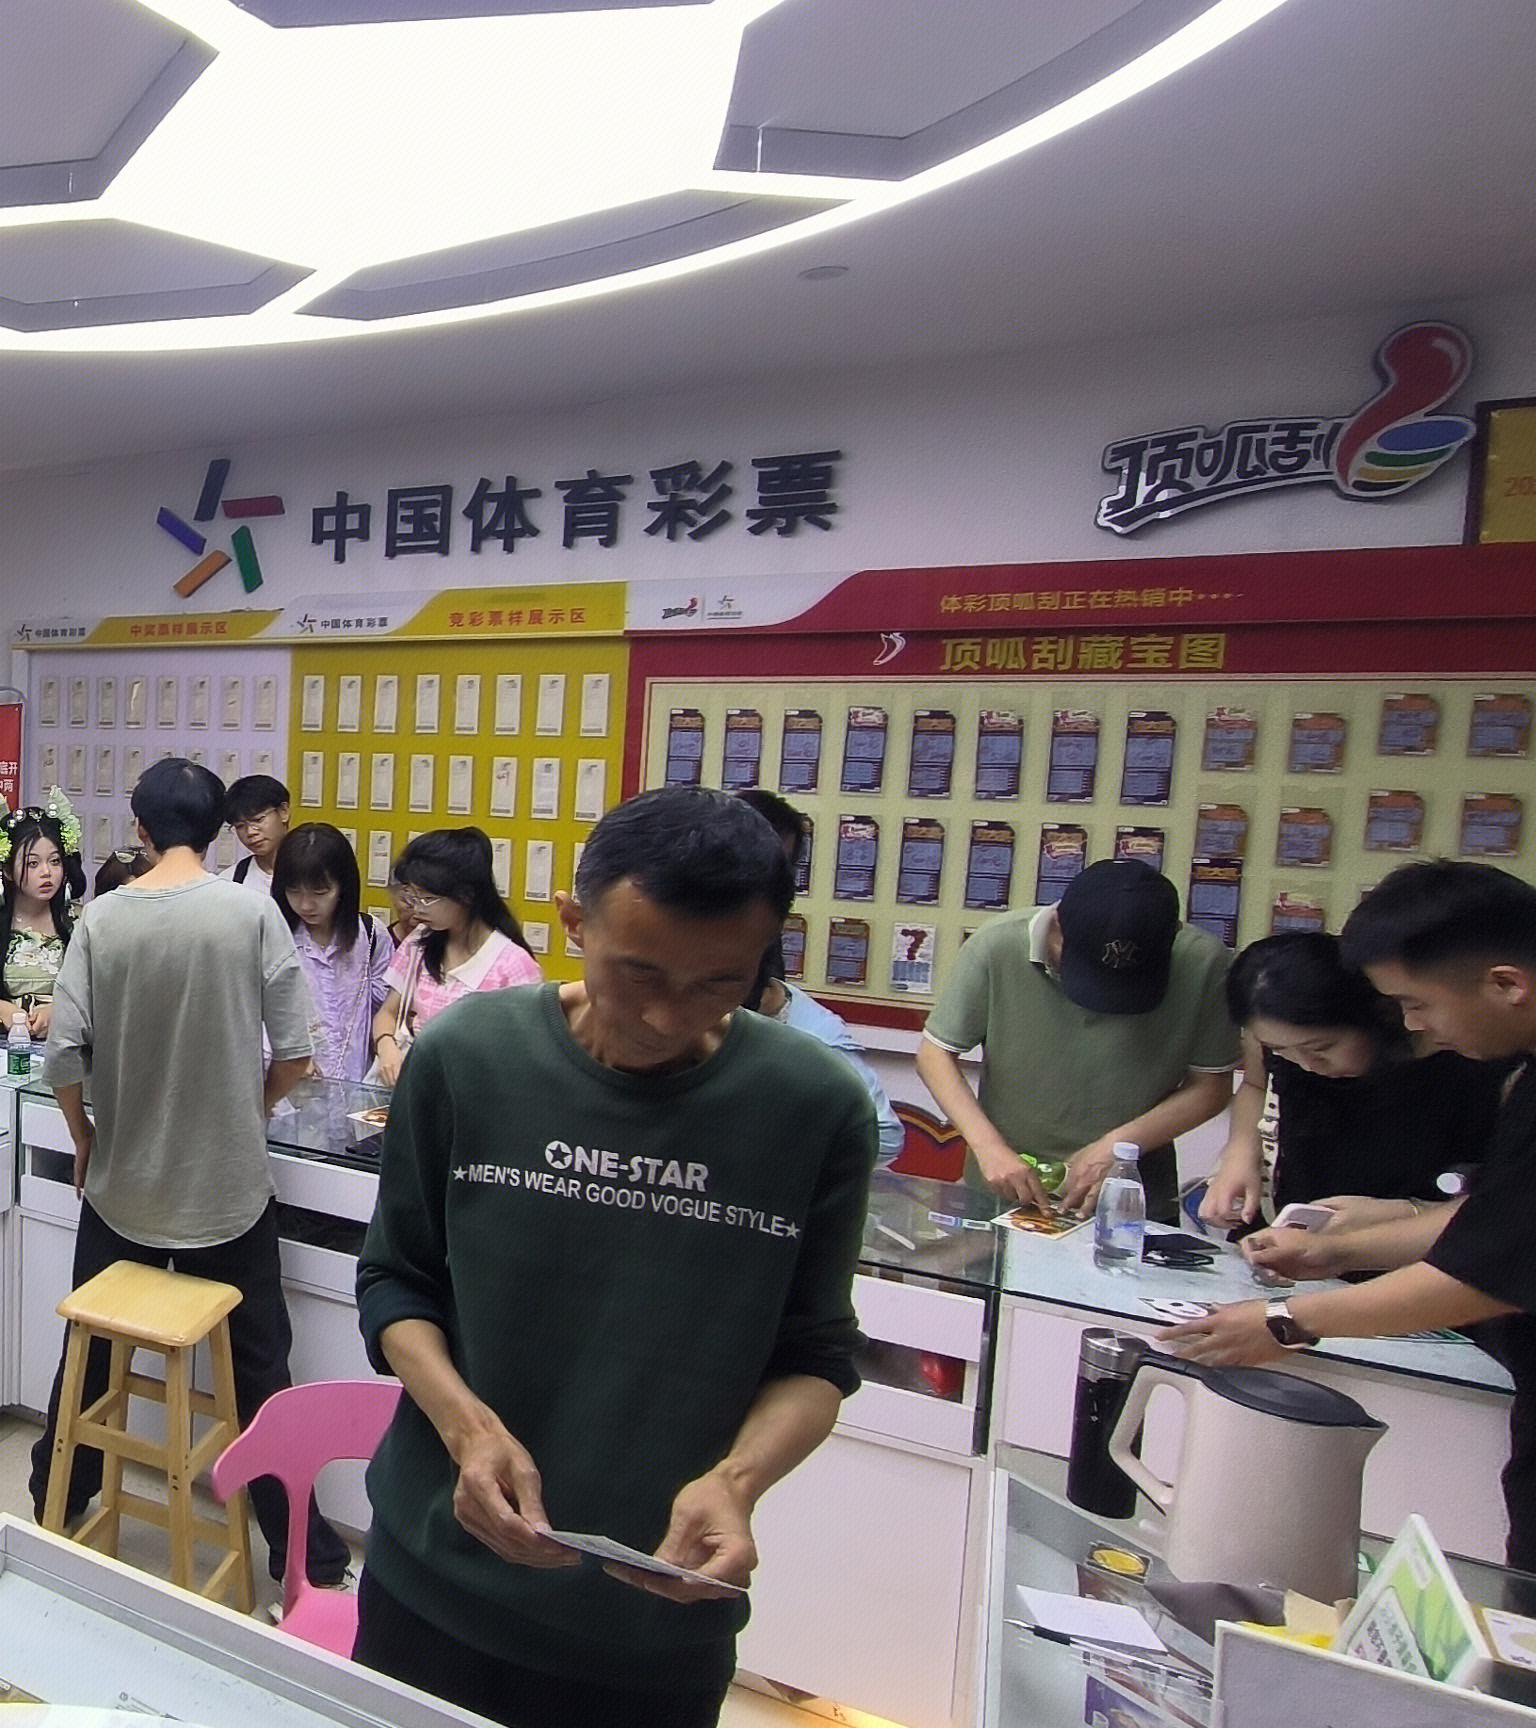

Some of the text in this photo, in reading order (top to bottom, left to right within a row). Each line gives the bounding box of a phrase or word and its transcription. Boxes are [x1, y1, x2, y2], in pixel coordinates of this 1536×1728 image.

[311, 449, 842, 565] 中国体育彩票
[130, 620, 228, 637] 中奖票样展示区
[321, 615, 388, 629] 中国体育彩票
[448, 607, 587, 628] 竞彩票样展示区
[939, 632, 1227, 672] 顶呱刮藏宝图
[544, 1139, 709, 1192] ONE-STAR
[467, 1163, 787, 1238] MEN'S WEAR GOOD VOGUE STYLE
